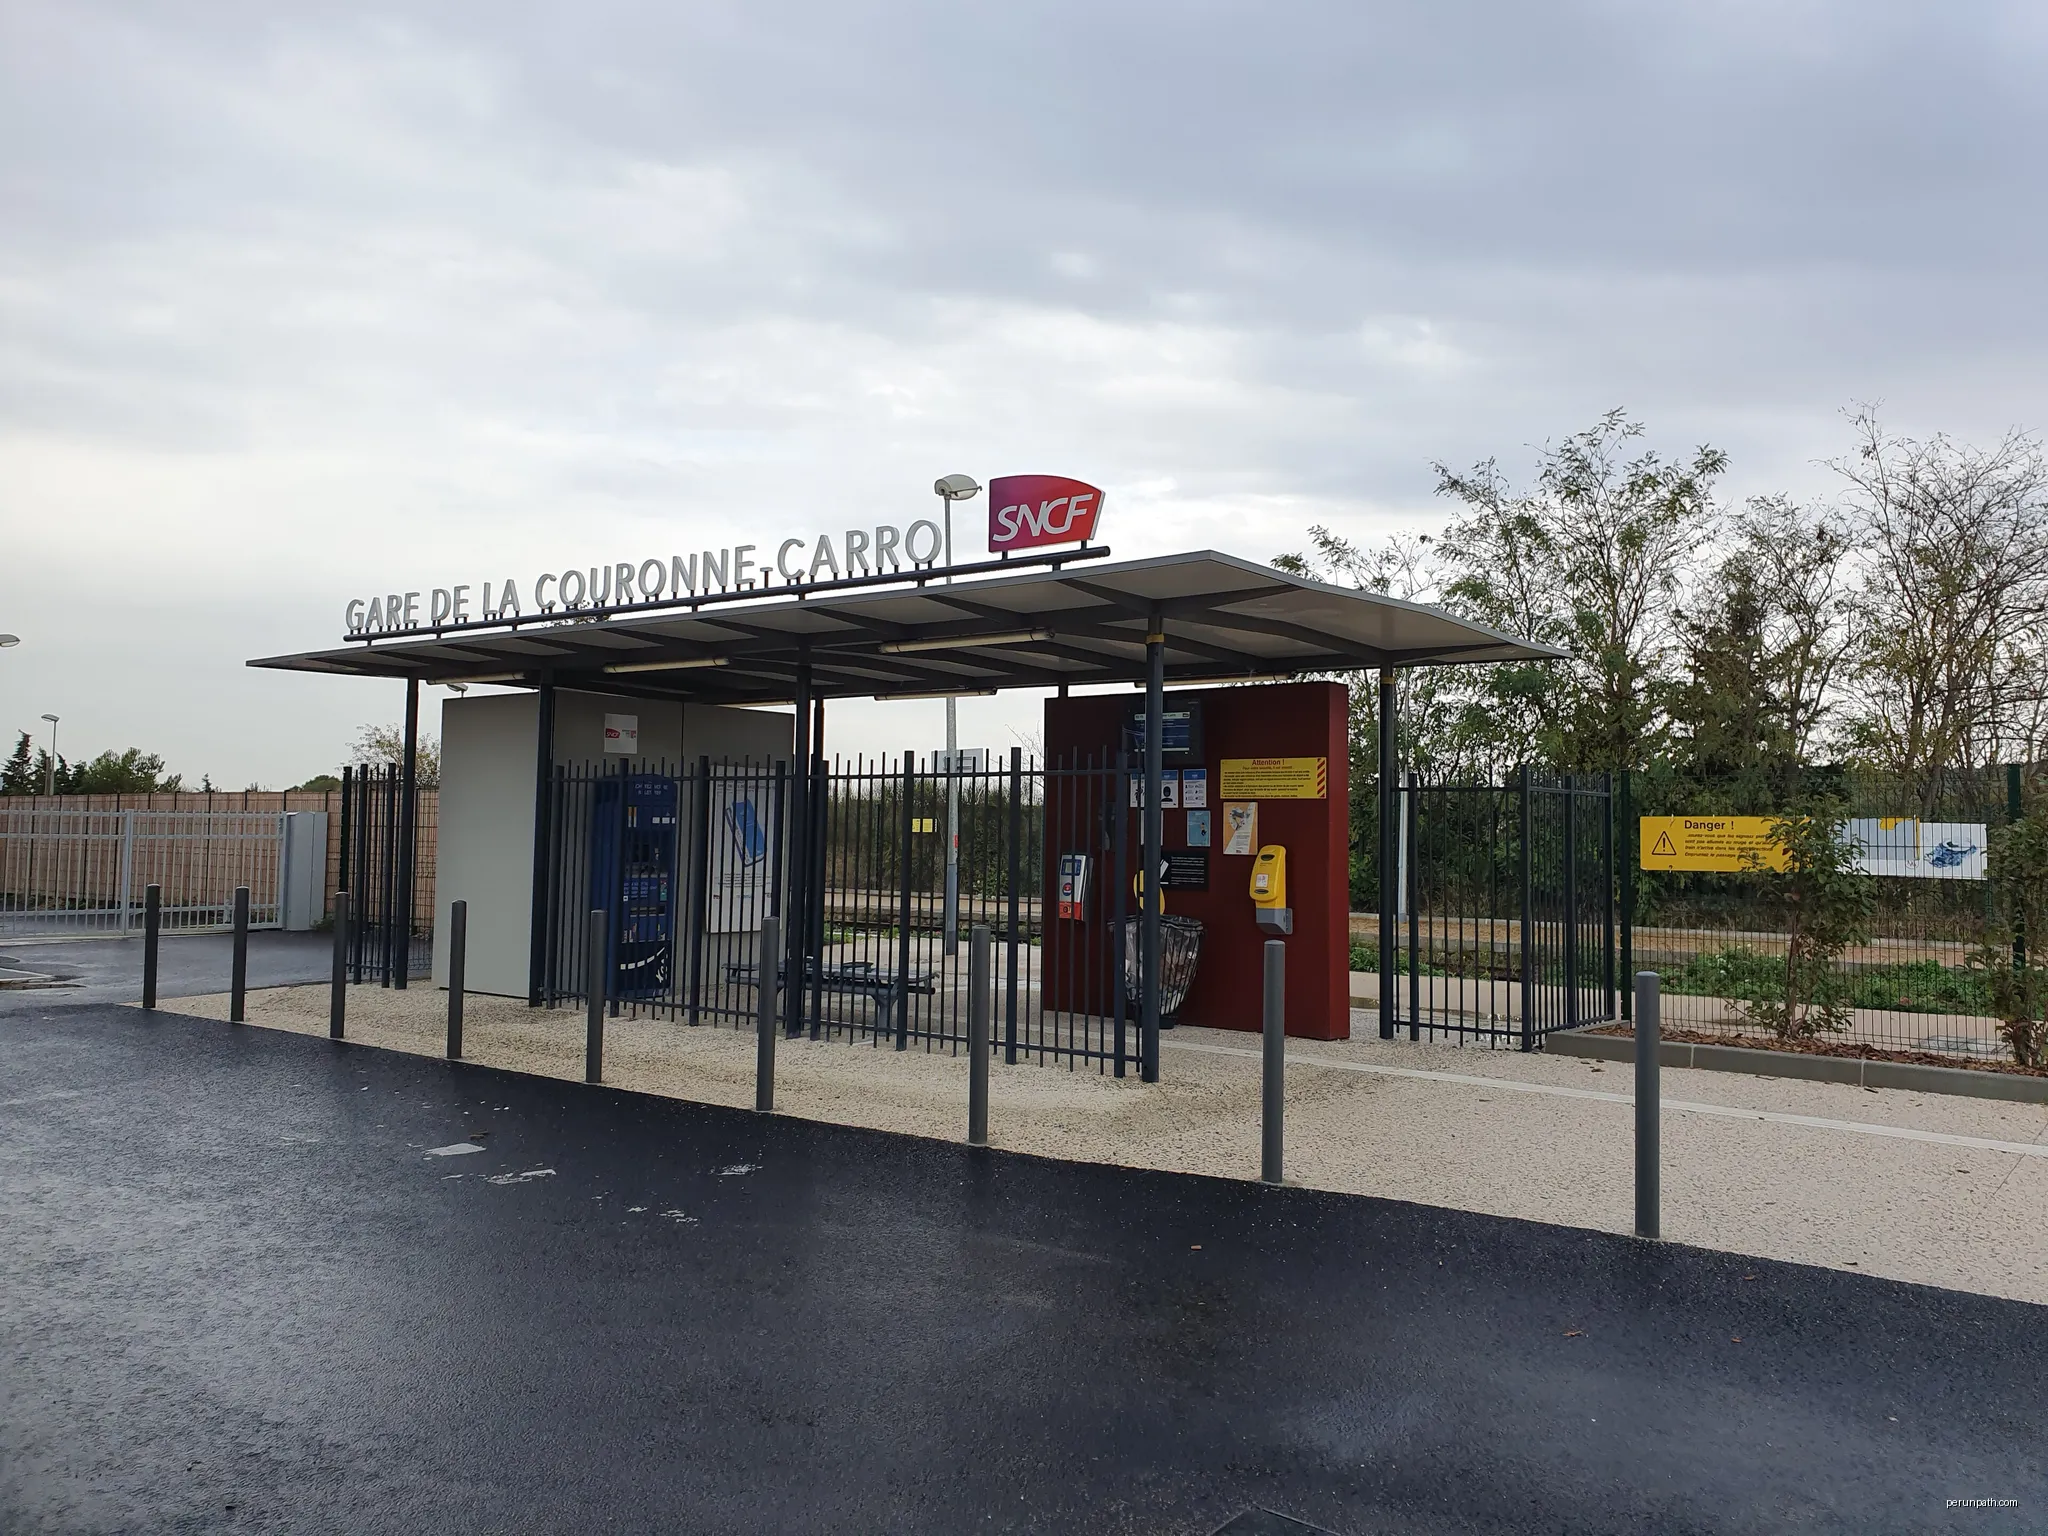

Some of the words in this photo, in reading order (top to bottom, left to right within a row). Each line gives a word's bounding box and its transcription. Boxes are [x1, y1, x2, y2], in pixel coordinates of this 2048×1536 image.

[992, 493, 1094, 542] SNCF
[345, 591, 421, 631] GARE
[431, 585, 470, 621] DE
[482, 579, 521, 615] LA
[1684, 820, 1726, 832] Danger
[1731, 820, 1734, 830] !
